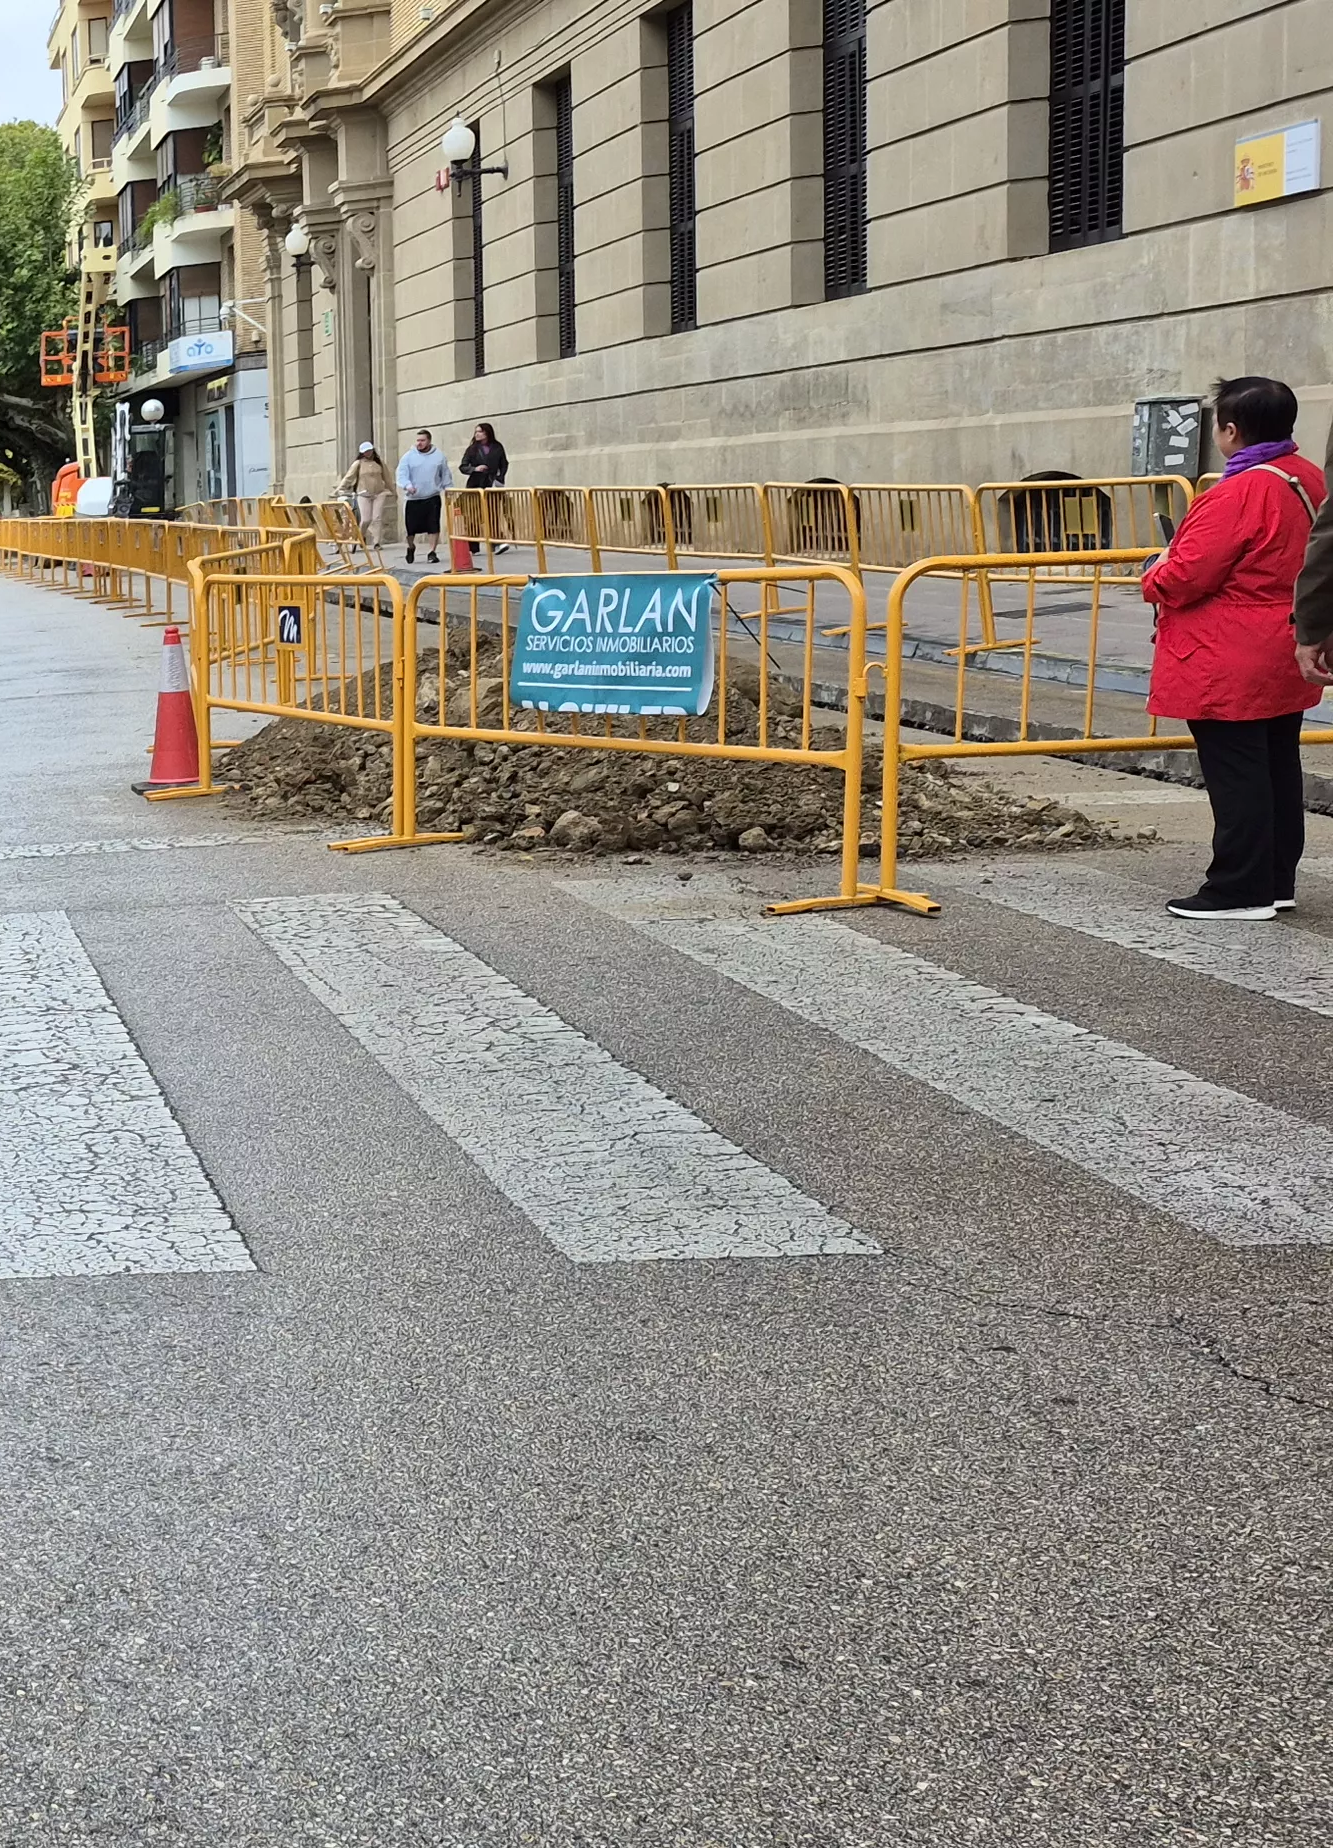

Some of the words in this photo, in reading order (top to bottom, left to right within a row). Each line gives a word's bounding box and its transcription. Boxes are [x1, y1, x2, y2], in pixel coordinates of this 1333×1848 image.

[531, 588, 698, 633] GARLAN
[525, 635, 592, 653] SERVICIOS
[595, 636, 694, 653] INMOBILIARIOS
